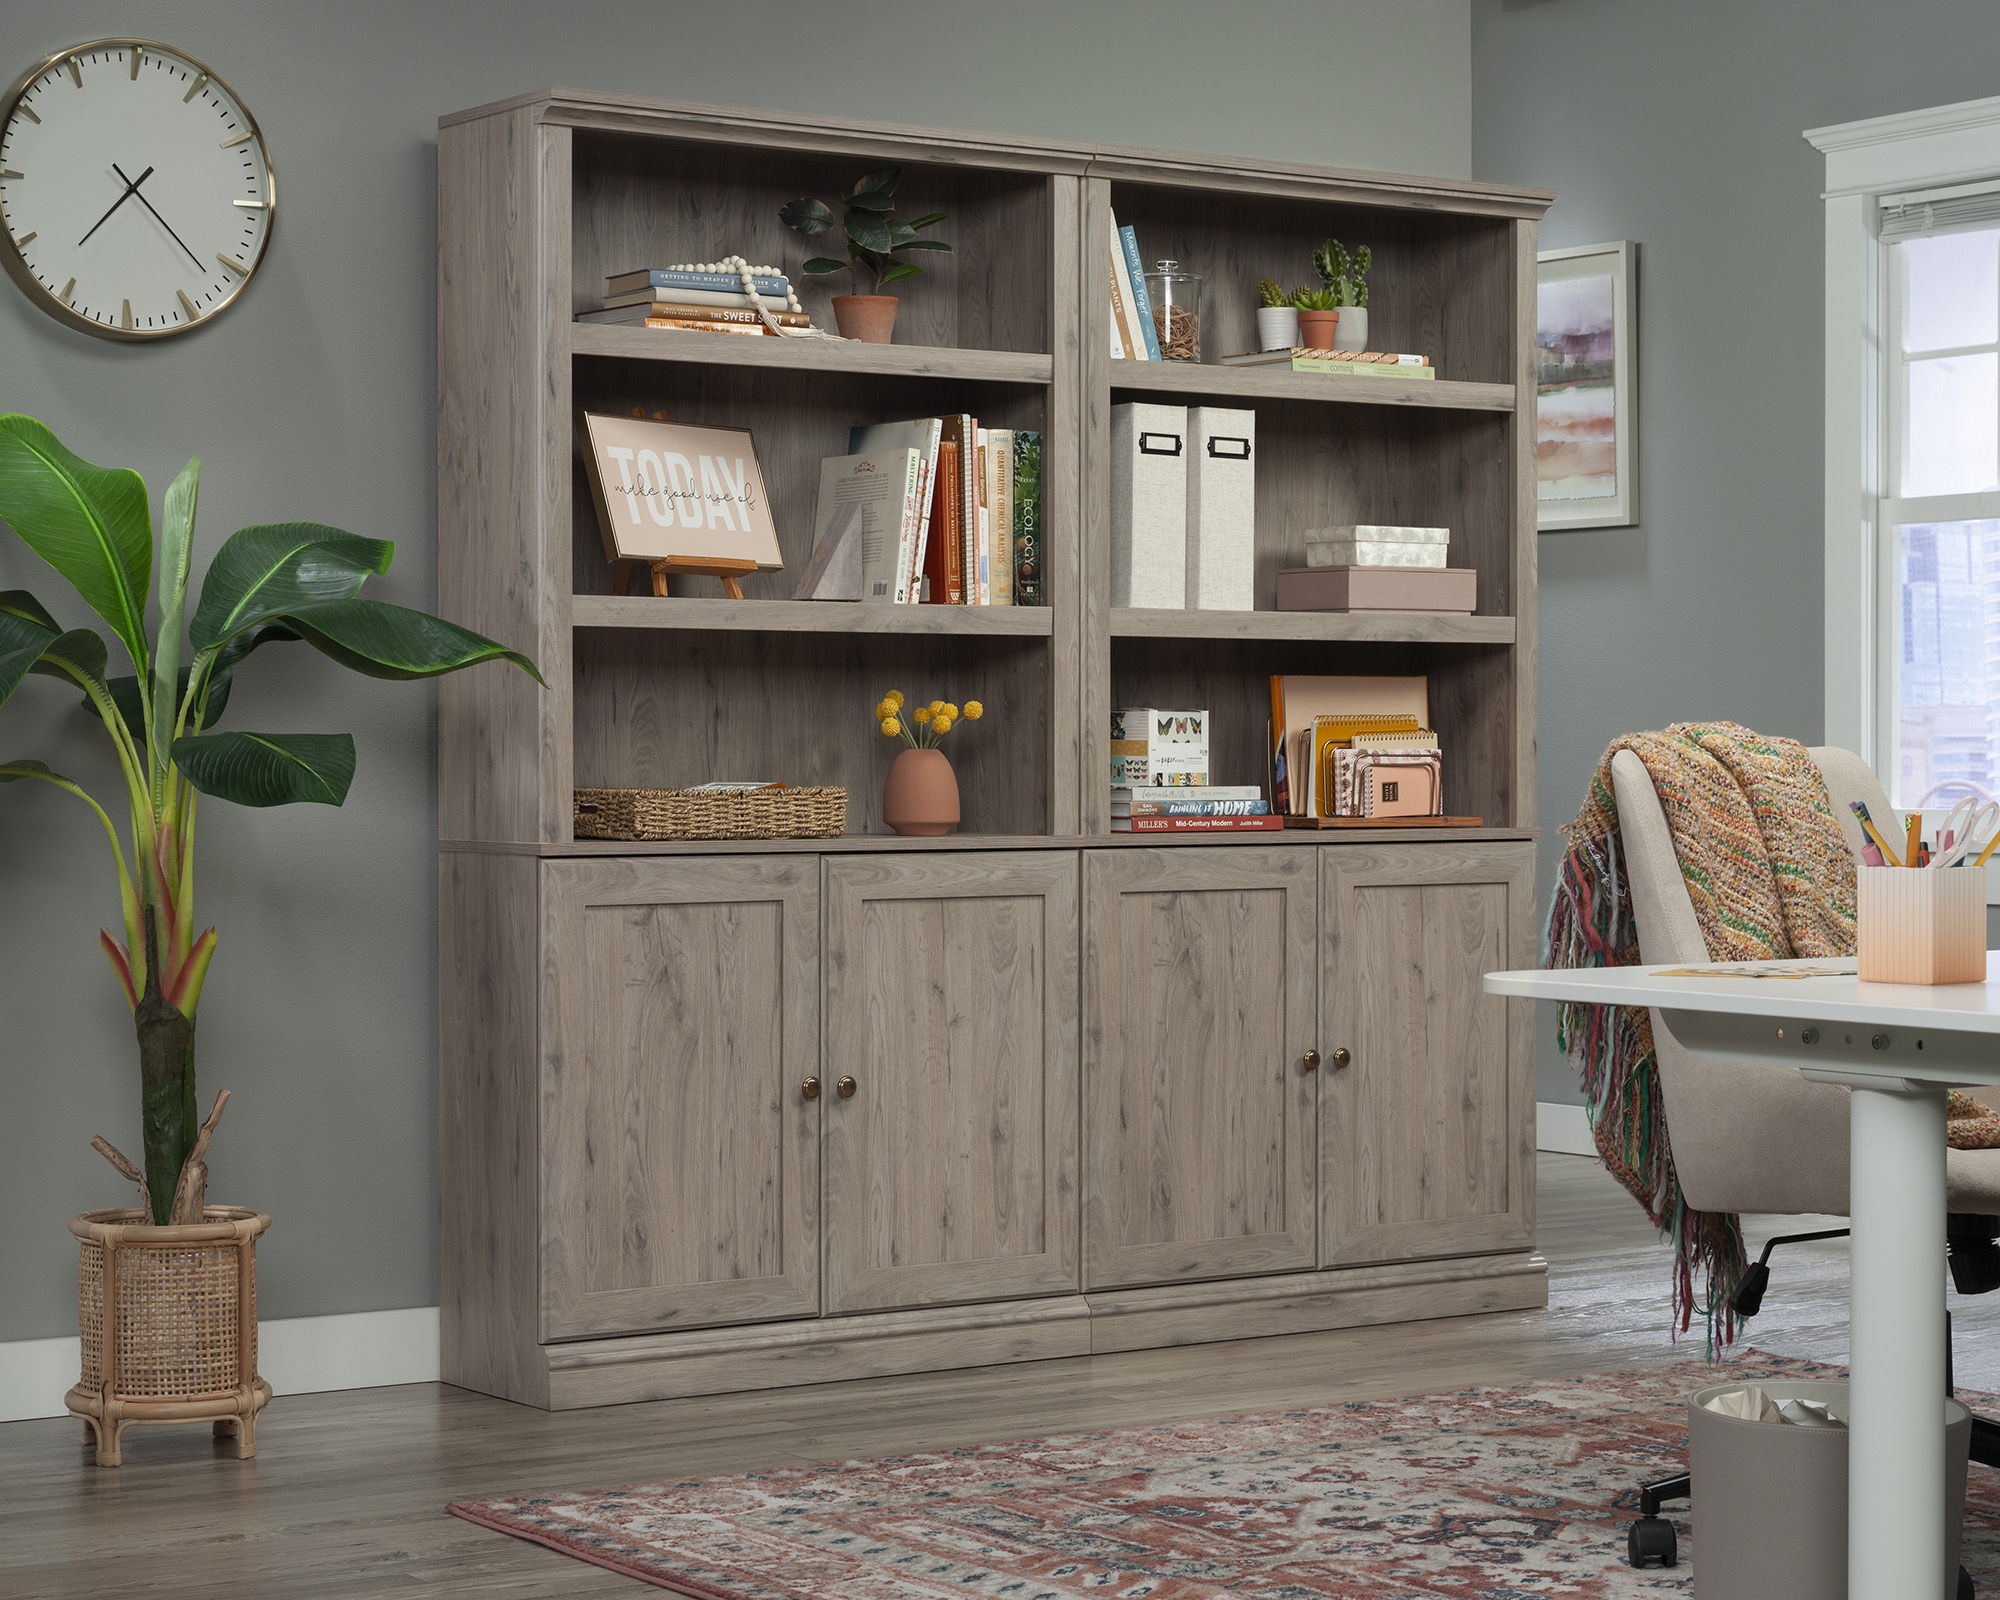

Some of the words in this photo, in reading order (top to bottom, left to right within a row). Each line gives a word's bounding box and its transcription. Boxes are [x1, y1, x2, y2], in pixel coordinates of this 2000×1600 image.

[1125, 231, 1139, 267] Moments
[660, 273, 689, 281] GETTING
[703, 275, 729, 283] HEAVEN
[1133, 269, 1142, 286] We
[1110, 280, 1122, 313] PLANTS
[1136, 289, 1150, 317] Forget
[724, 311, 756, 323] SWEET
[758, 314, 783, 324] SOT
[908, 455, 916, 495] MASTERING
[997, 449, 1005, 496] QUANTITATIVE
[607, 446, 752, 532] TODAY
[615, 474, 659, 496] make
[663, 478, 702, 510] good
[706, 494, 733, 504] use
[738, 482, 756, 511] of
[997, 498, 1005, 530] CHEMICAL
[997, 533, 1006, 563] ANALYSIS
[1023, 499, 1034, 566] ECOLOGY
[1138, 820, 1168, 828] MILLER'S
[1175, 820, 1210, 828] Mid-Century
[1169, 804, 1203, 814] BRINGING
[1203, 804, 1212, 813] IT
[1213, 801, 1252, 815] HOME
